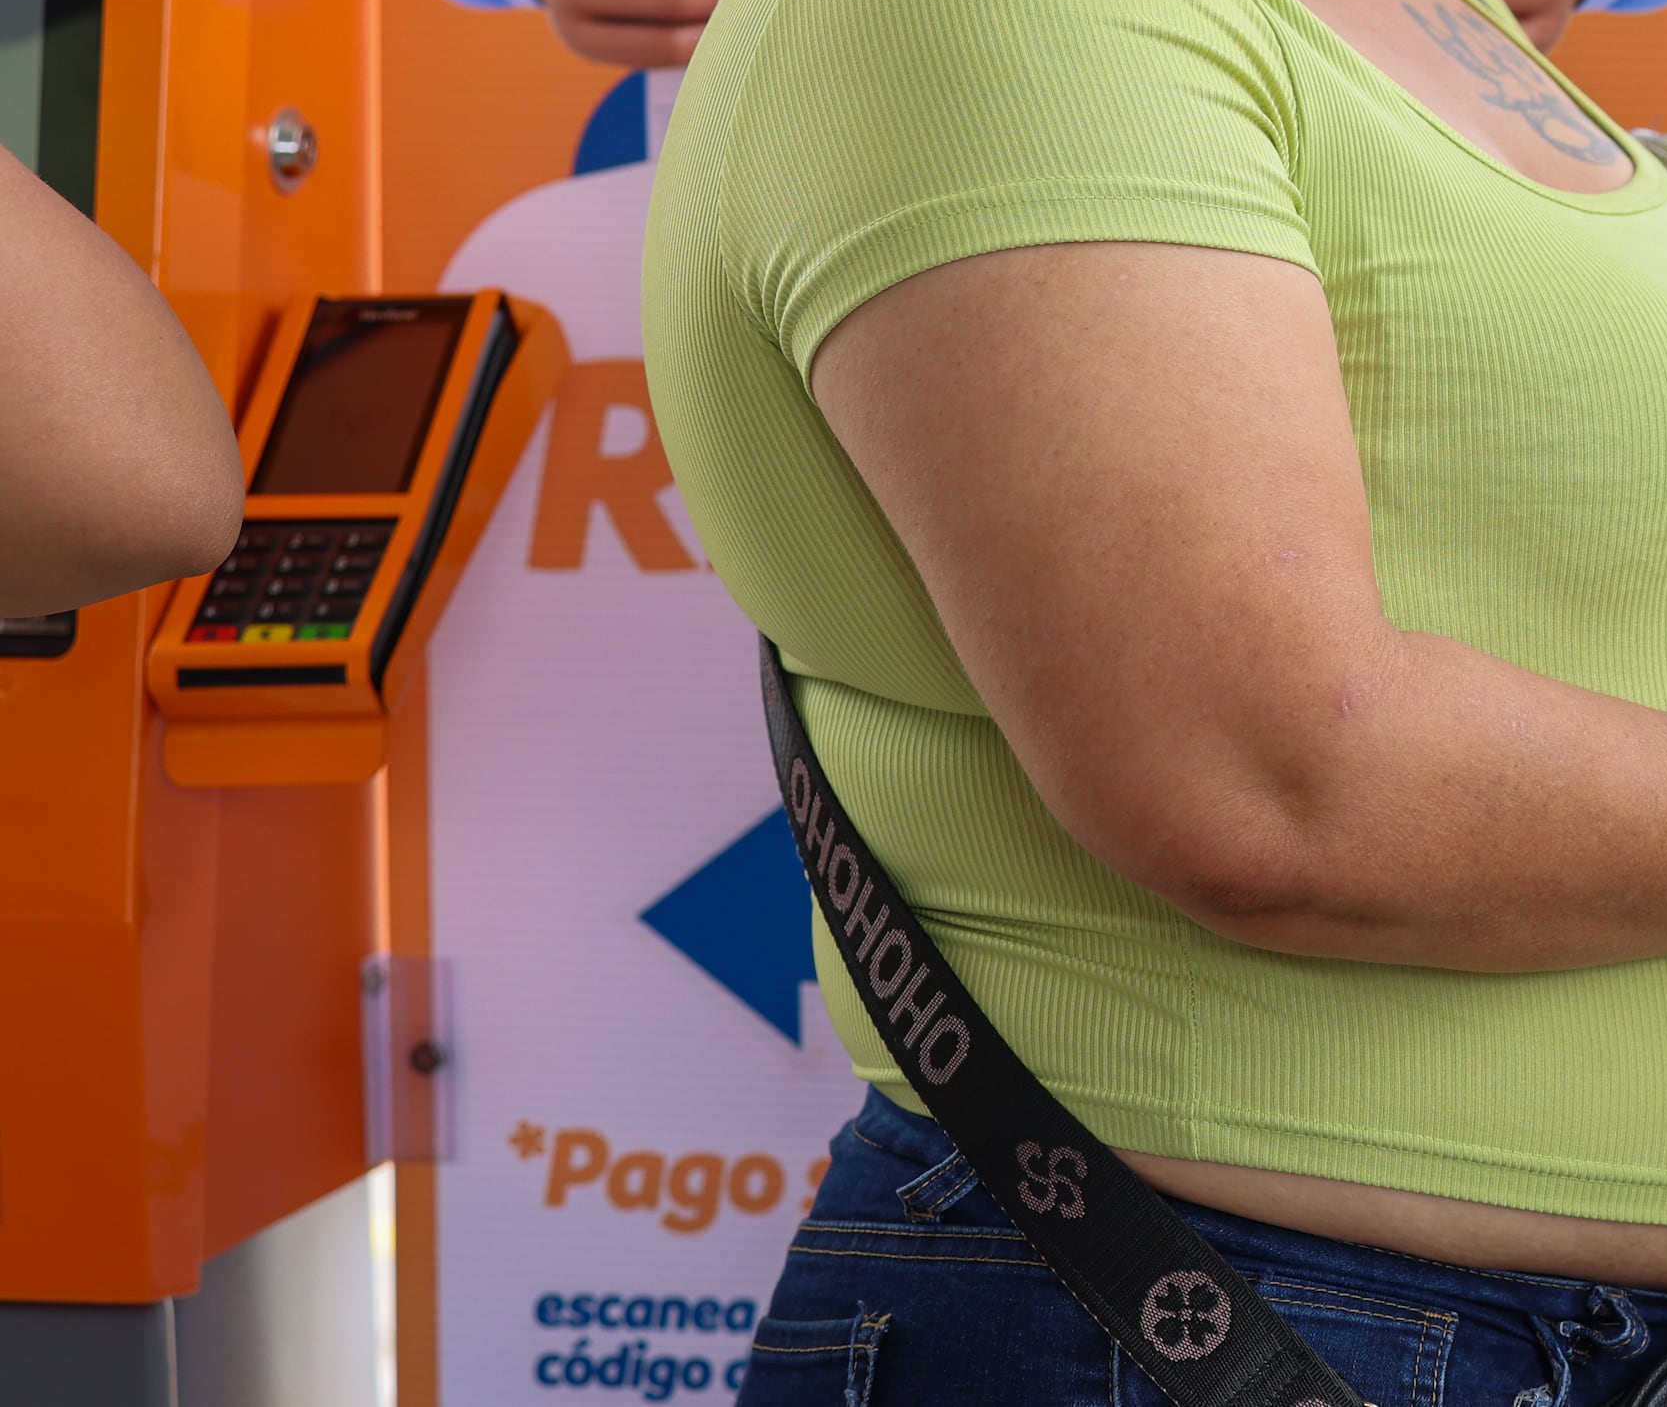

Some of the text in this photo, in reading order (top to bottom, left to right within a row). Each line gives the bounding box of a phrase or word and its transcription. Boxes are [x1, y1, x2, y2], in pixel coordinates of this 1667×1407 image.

[788, 757, 971, 1086] OHOHOHO
[536, 1292, 758, 1332] escanea
[536, 1339, 712, 1401] código
